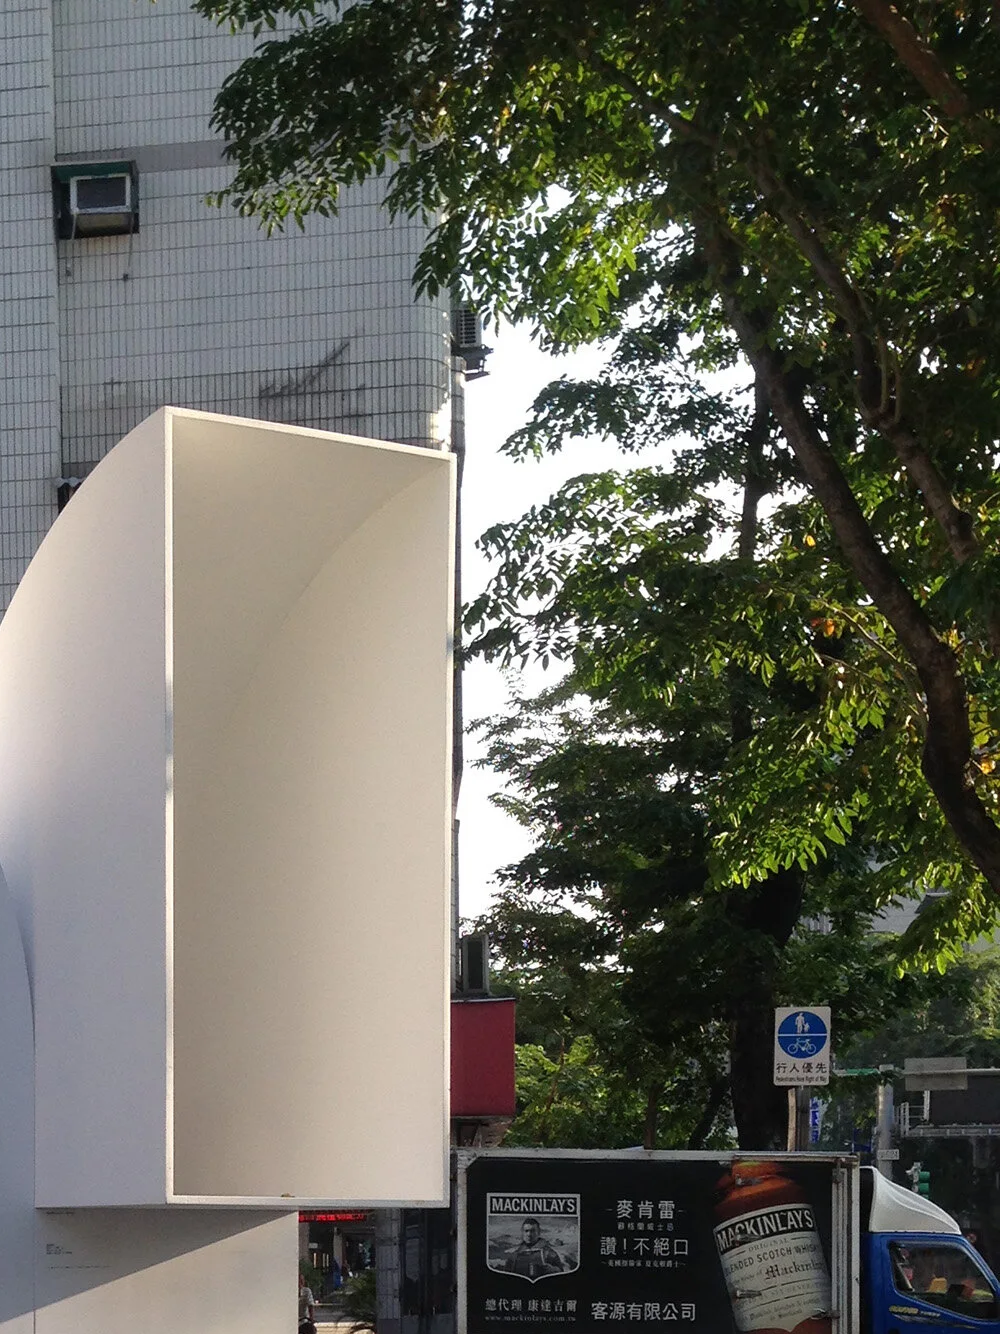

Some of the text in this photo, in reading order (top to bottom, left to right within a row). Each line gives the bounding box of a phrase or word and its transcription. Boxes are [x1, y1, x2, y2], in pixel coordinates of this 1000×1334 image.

[776, 1062, 827, 1074] 行人優先
[616, 1199, 675, 1219] 麥肯雷
[757, 1246, 792, 1263] SCOTCH
[591, 1301, 696, 1322] 客源有限公司
